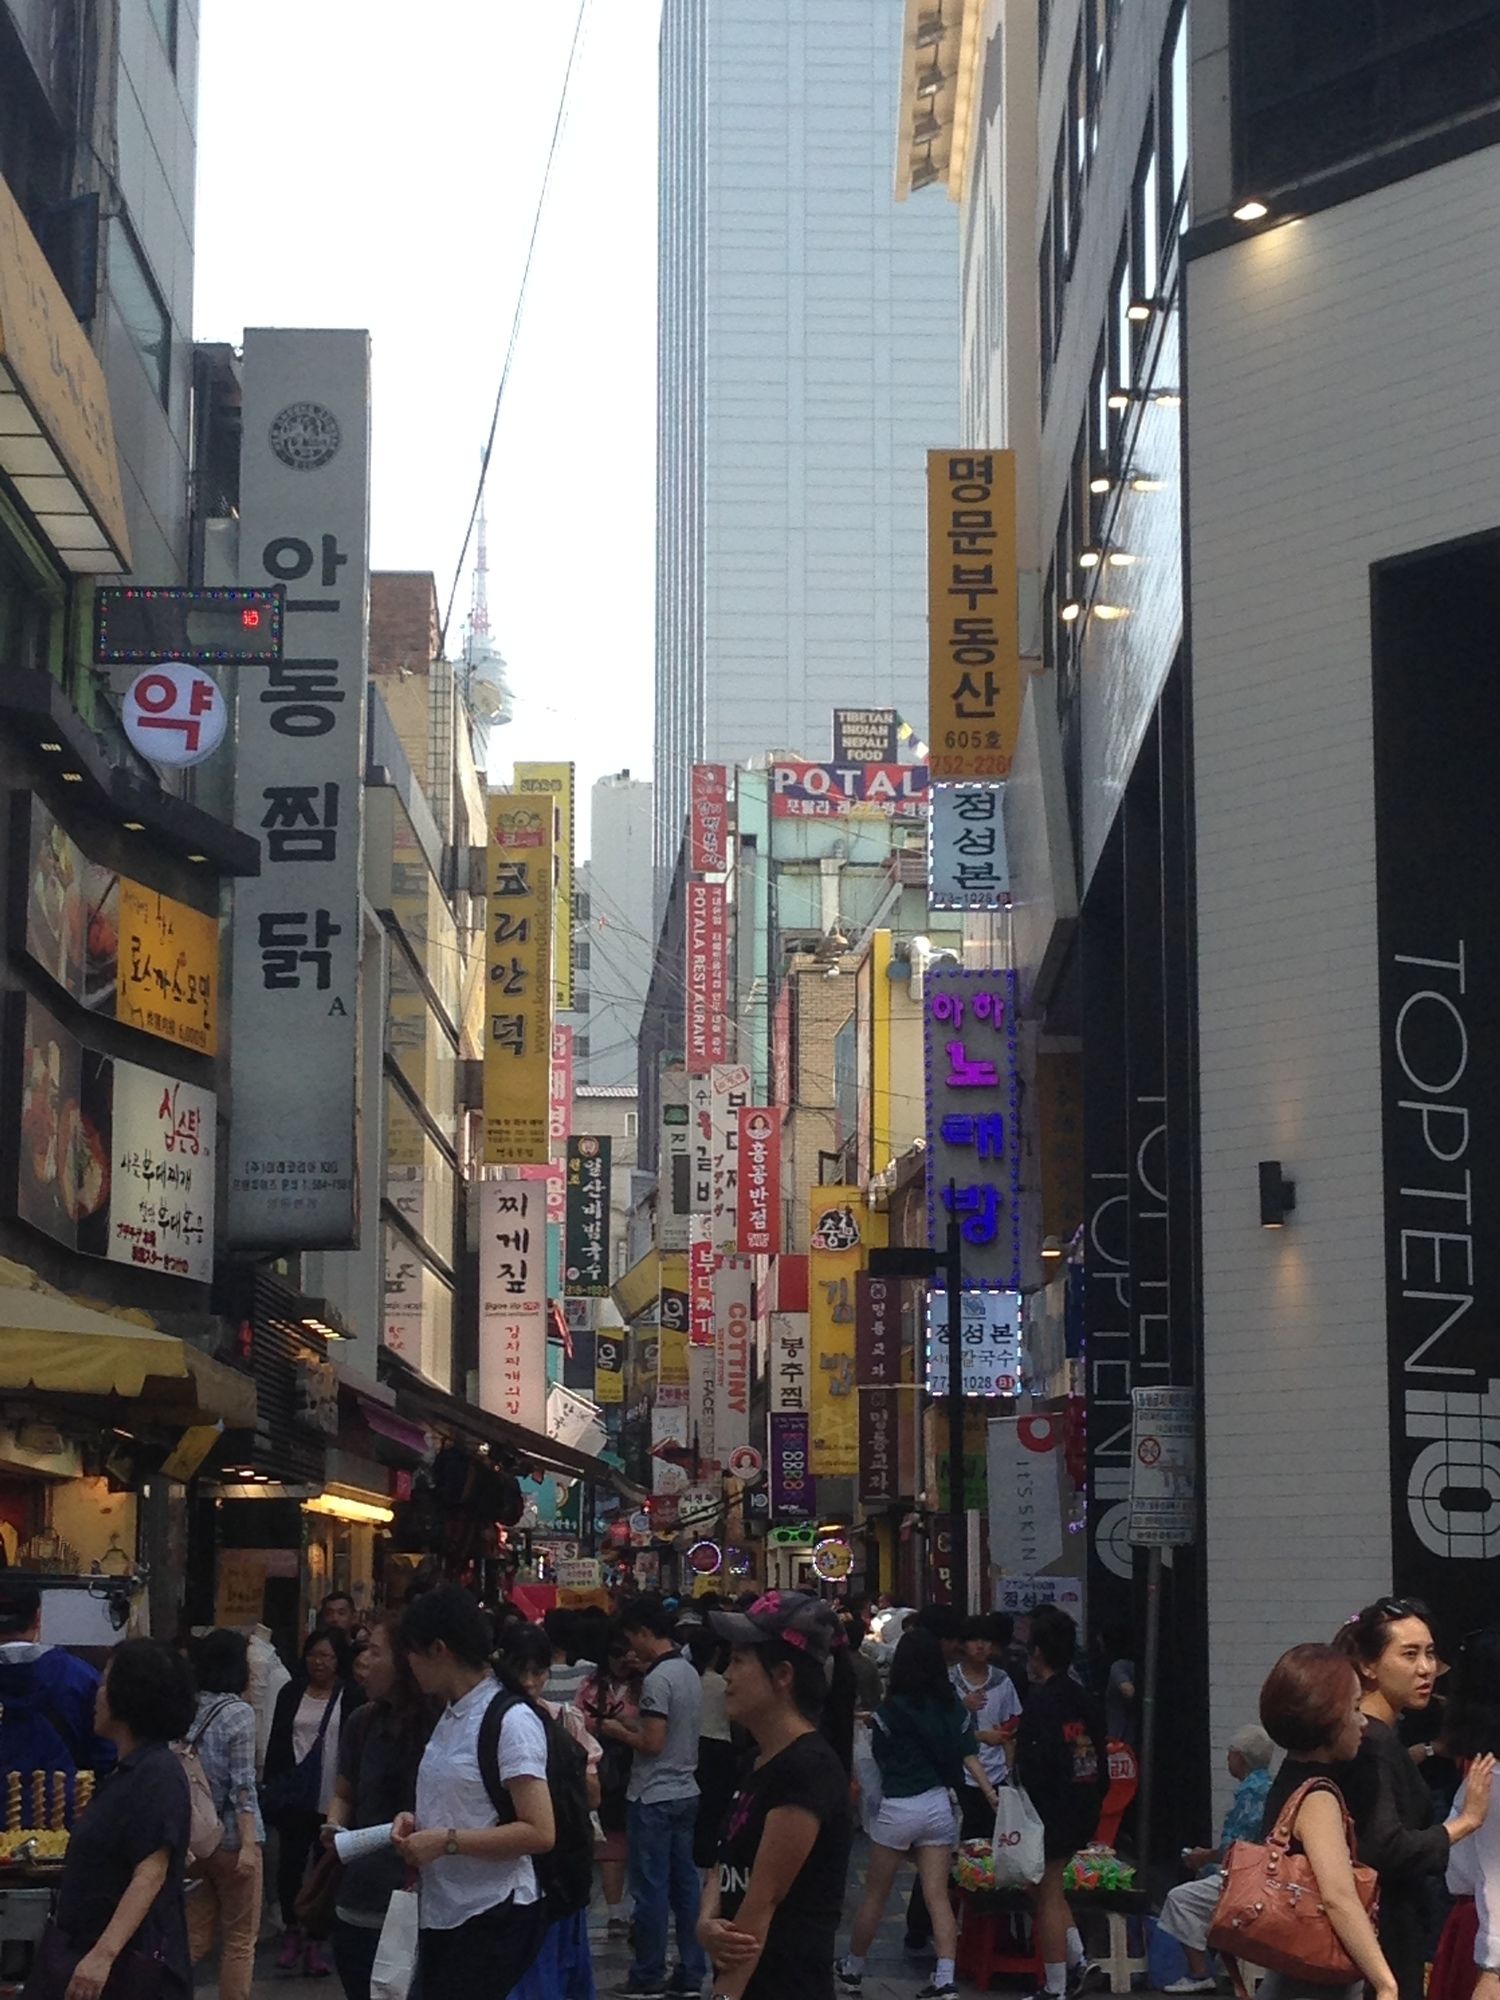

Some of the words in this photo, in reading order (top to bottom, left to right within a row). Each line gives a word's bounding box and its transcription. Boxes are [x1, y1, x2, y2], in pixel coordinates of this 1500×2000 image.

[946, 456, 999, 719] 명문부동산
[134, 673, 214, 751] 약
[838, 711, 893, 723] TIBETAN
[842, 725, 888, 736] INDIAN
[842, 737, 888, 748] NEPALI
[944, 731, 1001, 749] 605호
[258, 534, 348, 990] 안동찜닭
[847, 750, 883, 761] FOOD
[952, 791, 1002, 890] 정성본
[693, 887, 706, 950] POTALA
[490, 861, 532, 1057] 코리안덕
[693, 954, 706, 1056] RESTAURANT
[931, 992, 1005, 1030] 아하
[940, 1040, 1004, 1244] 노래방
[747, 1141, 770, 1230] 홍콩반점
[727, 1302, 748, 1414] COTTINY
[870, 1302, 887, 1377] 명동교자
[935, 1323, 1015, 1345] 정성본
[779, 1337, 804, 1409] 봉추찜
[867, 1408, 890, 1490] 명동교자
